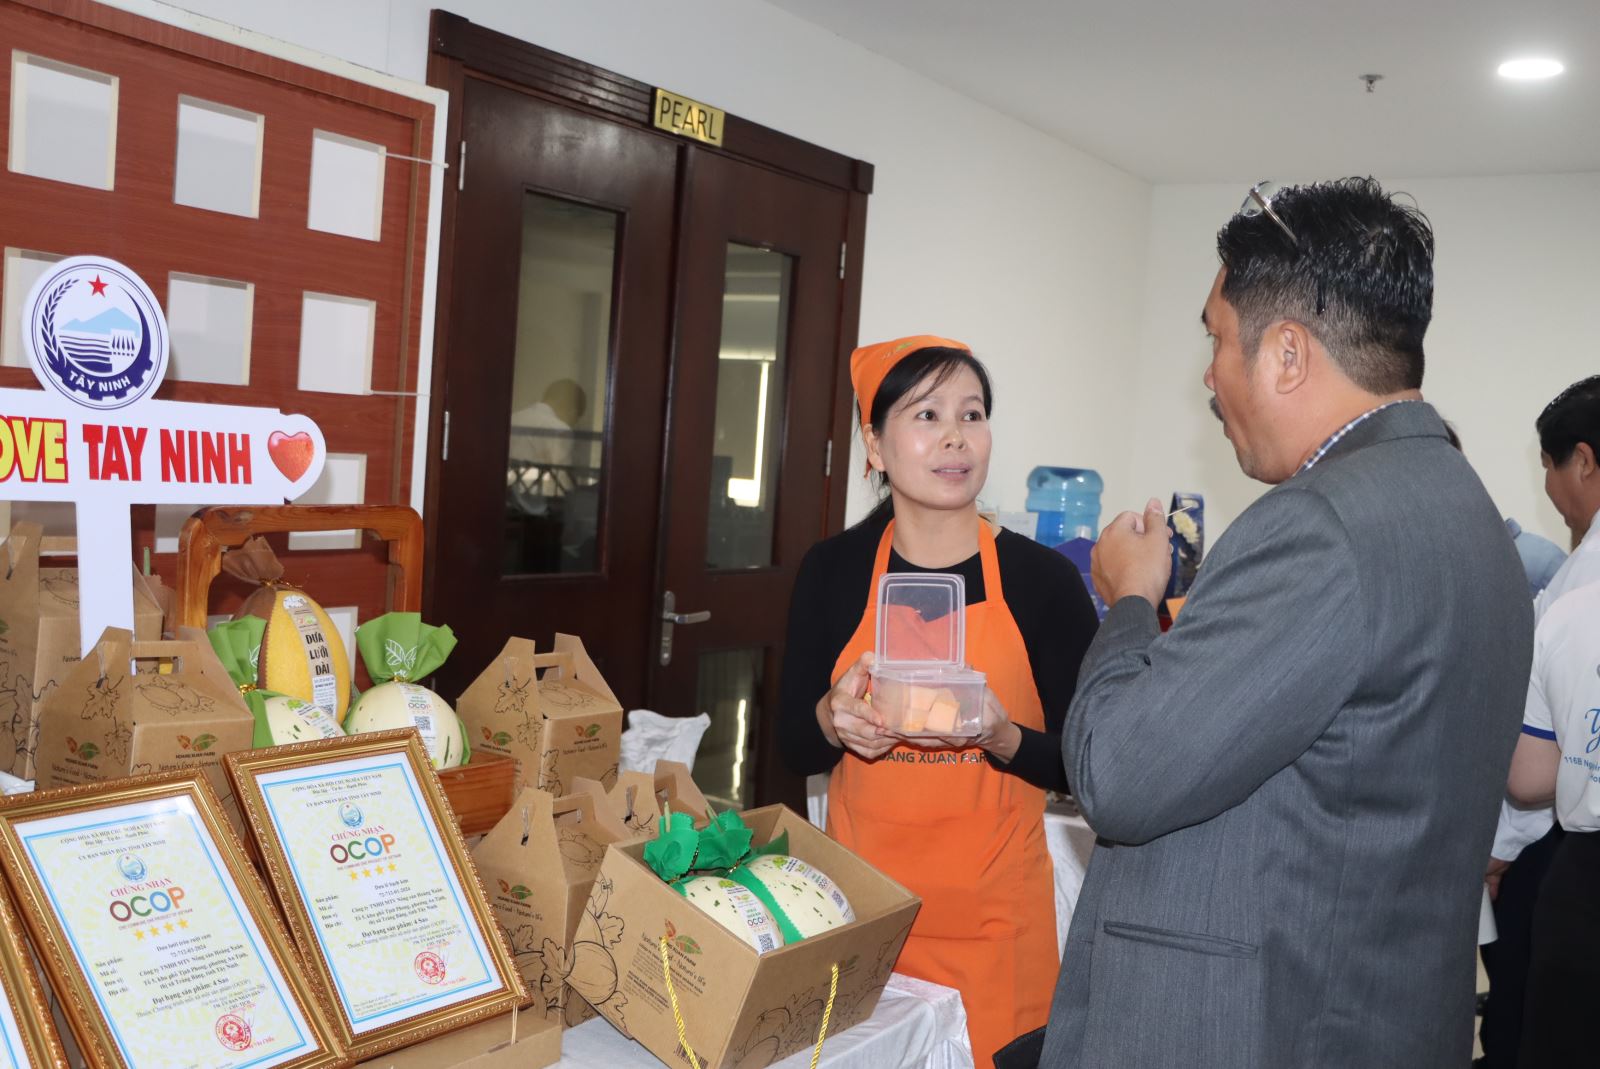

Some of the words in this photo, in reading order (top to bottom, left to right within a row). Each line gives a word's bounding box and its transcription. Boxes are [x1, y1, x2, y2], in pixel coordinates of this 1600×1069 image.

[659, 96, 717, 140] PEARL
[70, 370, 96, 390] TÂY
[98, 375, 131, 392] NINH
[82, 424, 148, 482] TAY
[160, 428, 252, 485] NINH
[305, 632, 324, 645] DƯA
[309, 645, 329, 660] LƯỚI
[315, 662, 330, 676] DÀI
[886, 751, 915, 764] ANG
[918, 752, 957, 765] XUAN
[960, 752, 986, 764] FAR
[330, 833, 395, 864] OCOP
[110, 886, 185, 921] OCOP
